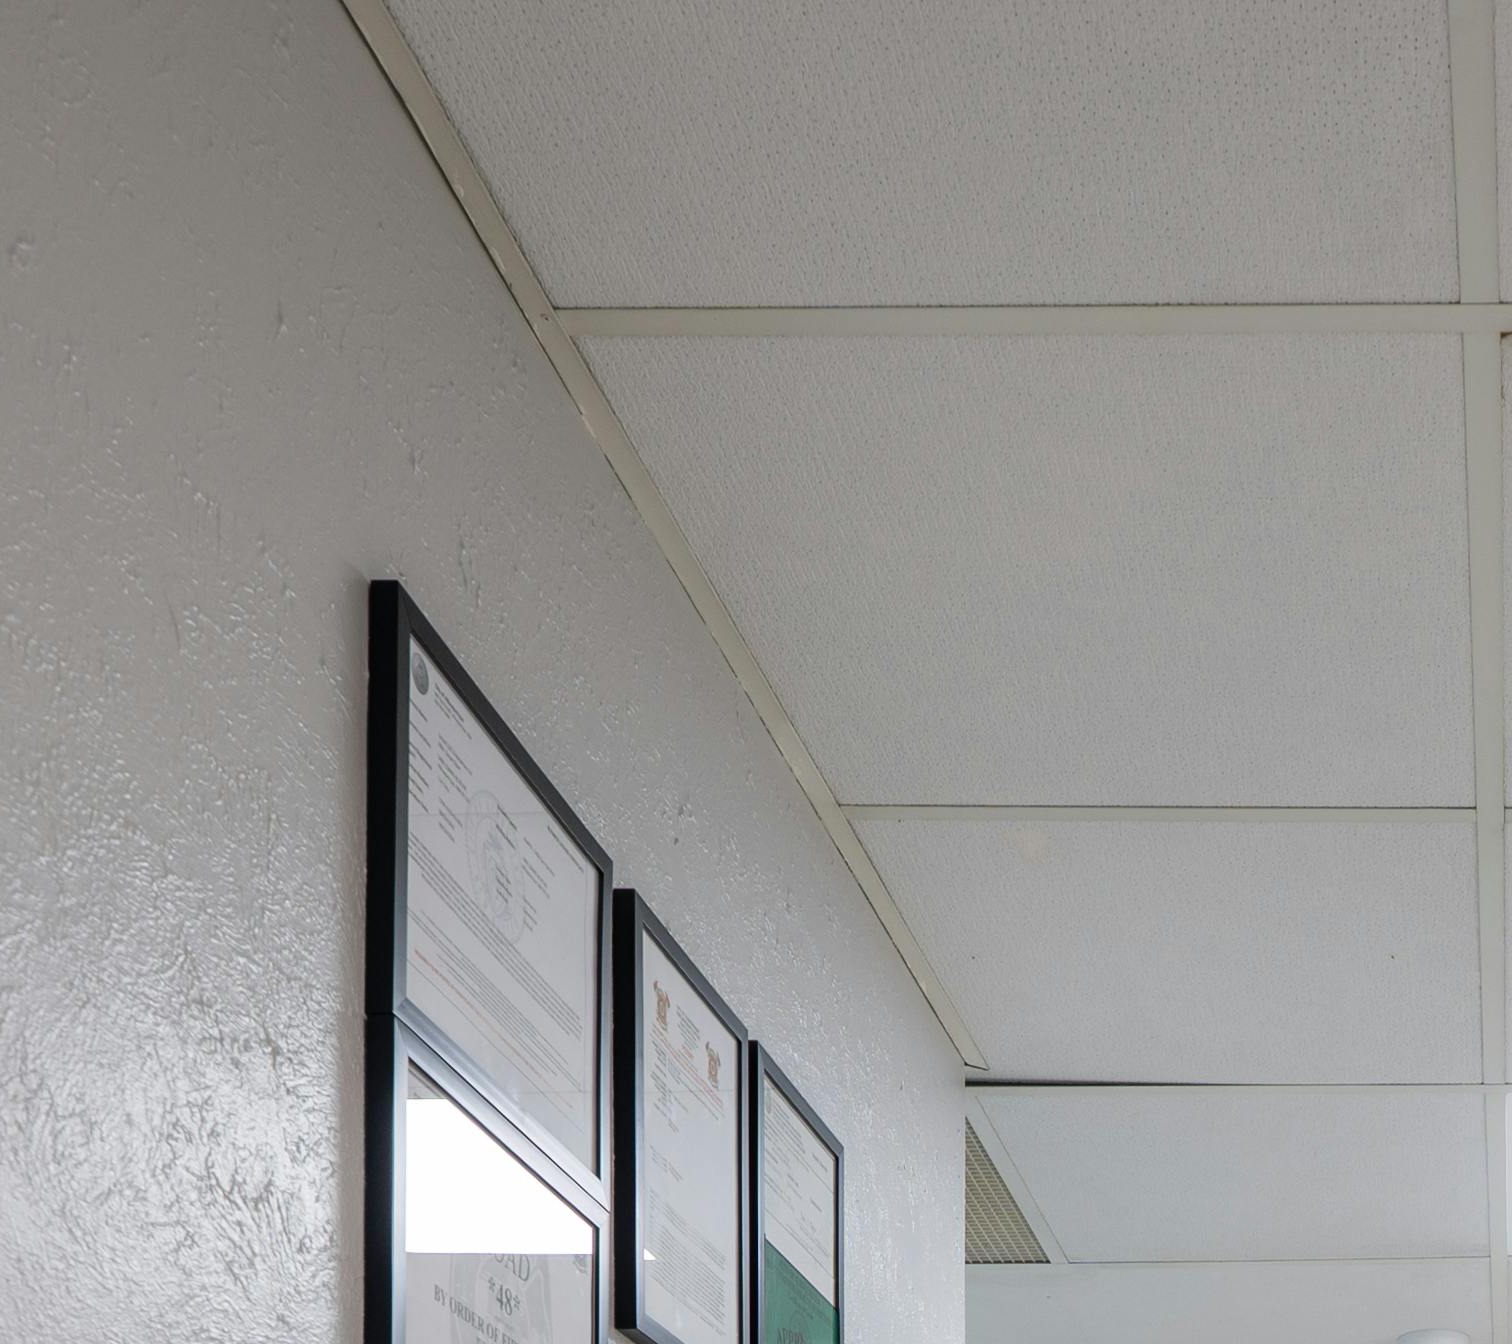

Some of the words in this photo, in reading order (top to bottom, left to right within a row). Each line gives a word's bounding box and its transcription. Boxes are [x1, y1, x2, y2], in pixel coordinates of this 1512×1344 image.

[434, 1284, 448, 1306] BY
[449, 1297, 485, 1334] ORDER
[486, 1322, 499, 1342] OF
